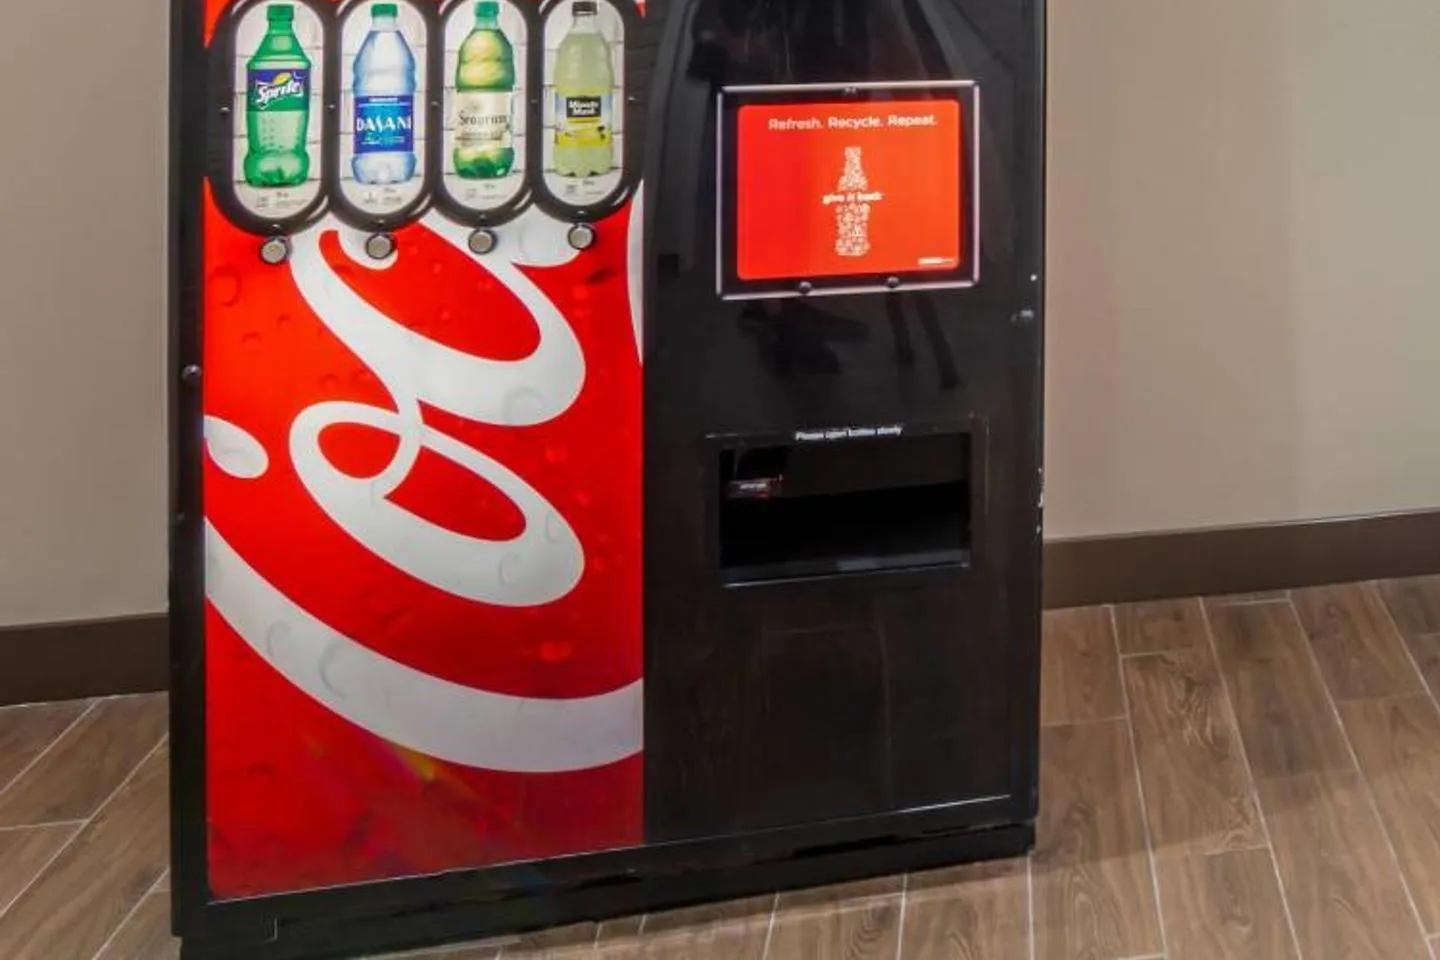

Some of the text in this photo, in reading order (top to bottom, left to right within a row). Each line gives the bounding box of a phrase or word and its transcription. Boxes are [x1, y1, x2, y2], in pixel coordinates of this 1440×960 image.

[255, 80, 304, 110] Sprite
[356, 116, 412, 133] DASANI
[768, 114, 938, 130] Refresh. Recycle. Repeat.
